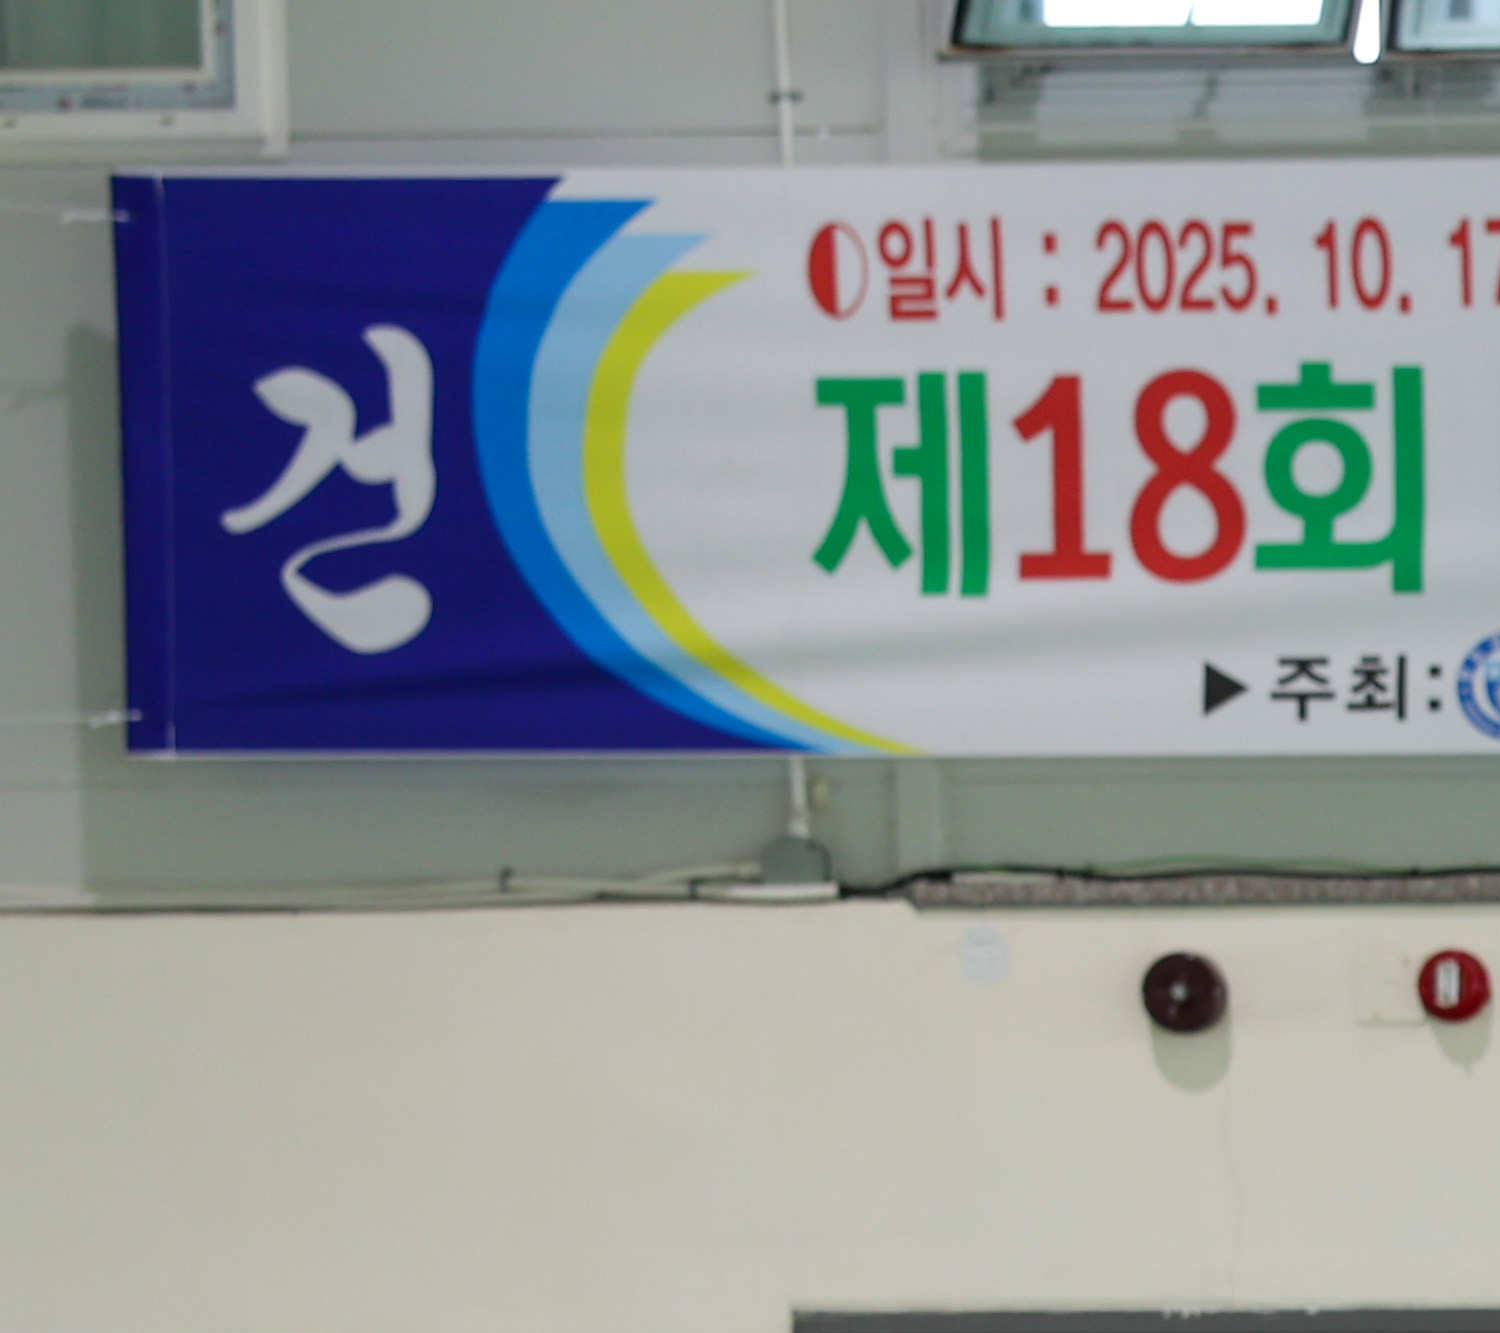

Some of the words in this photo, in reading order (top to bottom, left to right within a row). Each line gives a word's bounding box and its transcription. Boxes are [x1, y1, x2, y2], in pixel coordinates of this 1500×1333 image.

[878, 218, 1004, 321] 일시
[1096, 220, 1277, 315] 2025.
[1315, 218, 1411, 315] 10.
[813, 362, 1426, 597] 제18회
[1270, 655, 1441, 722] 주최:
